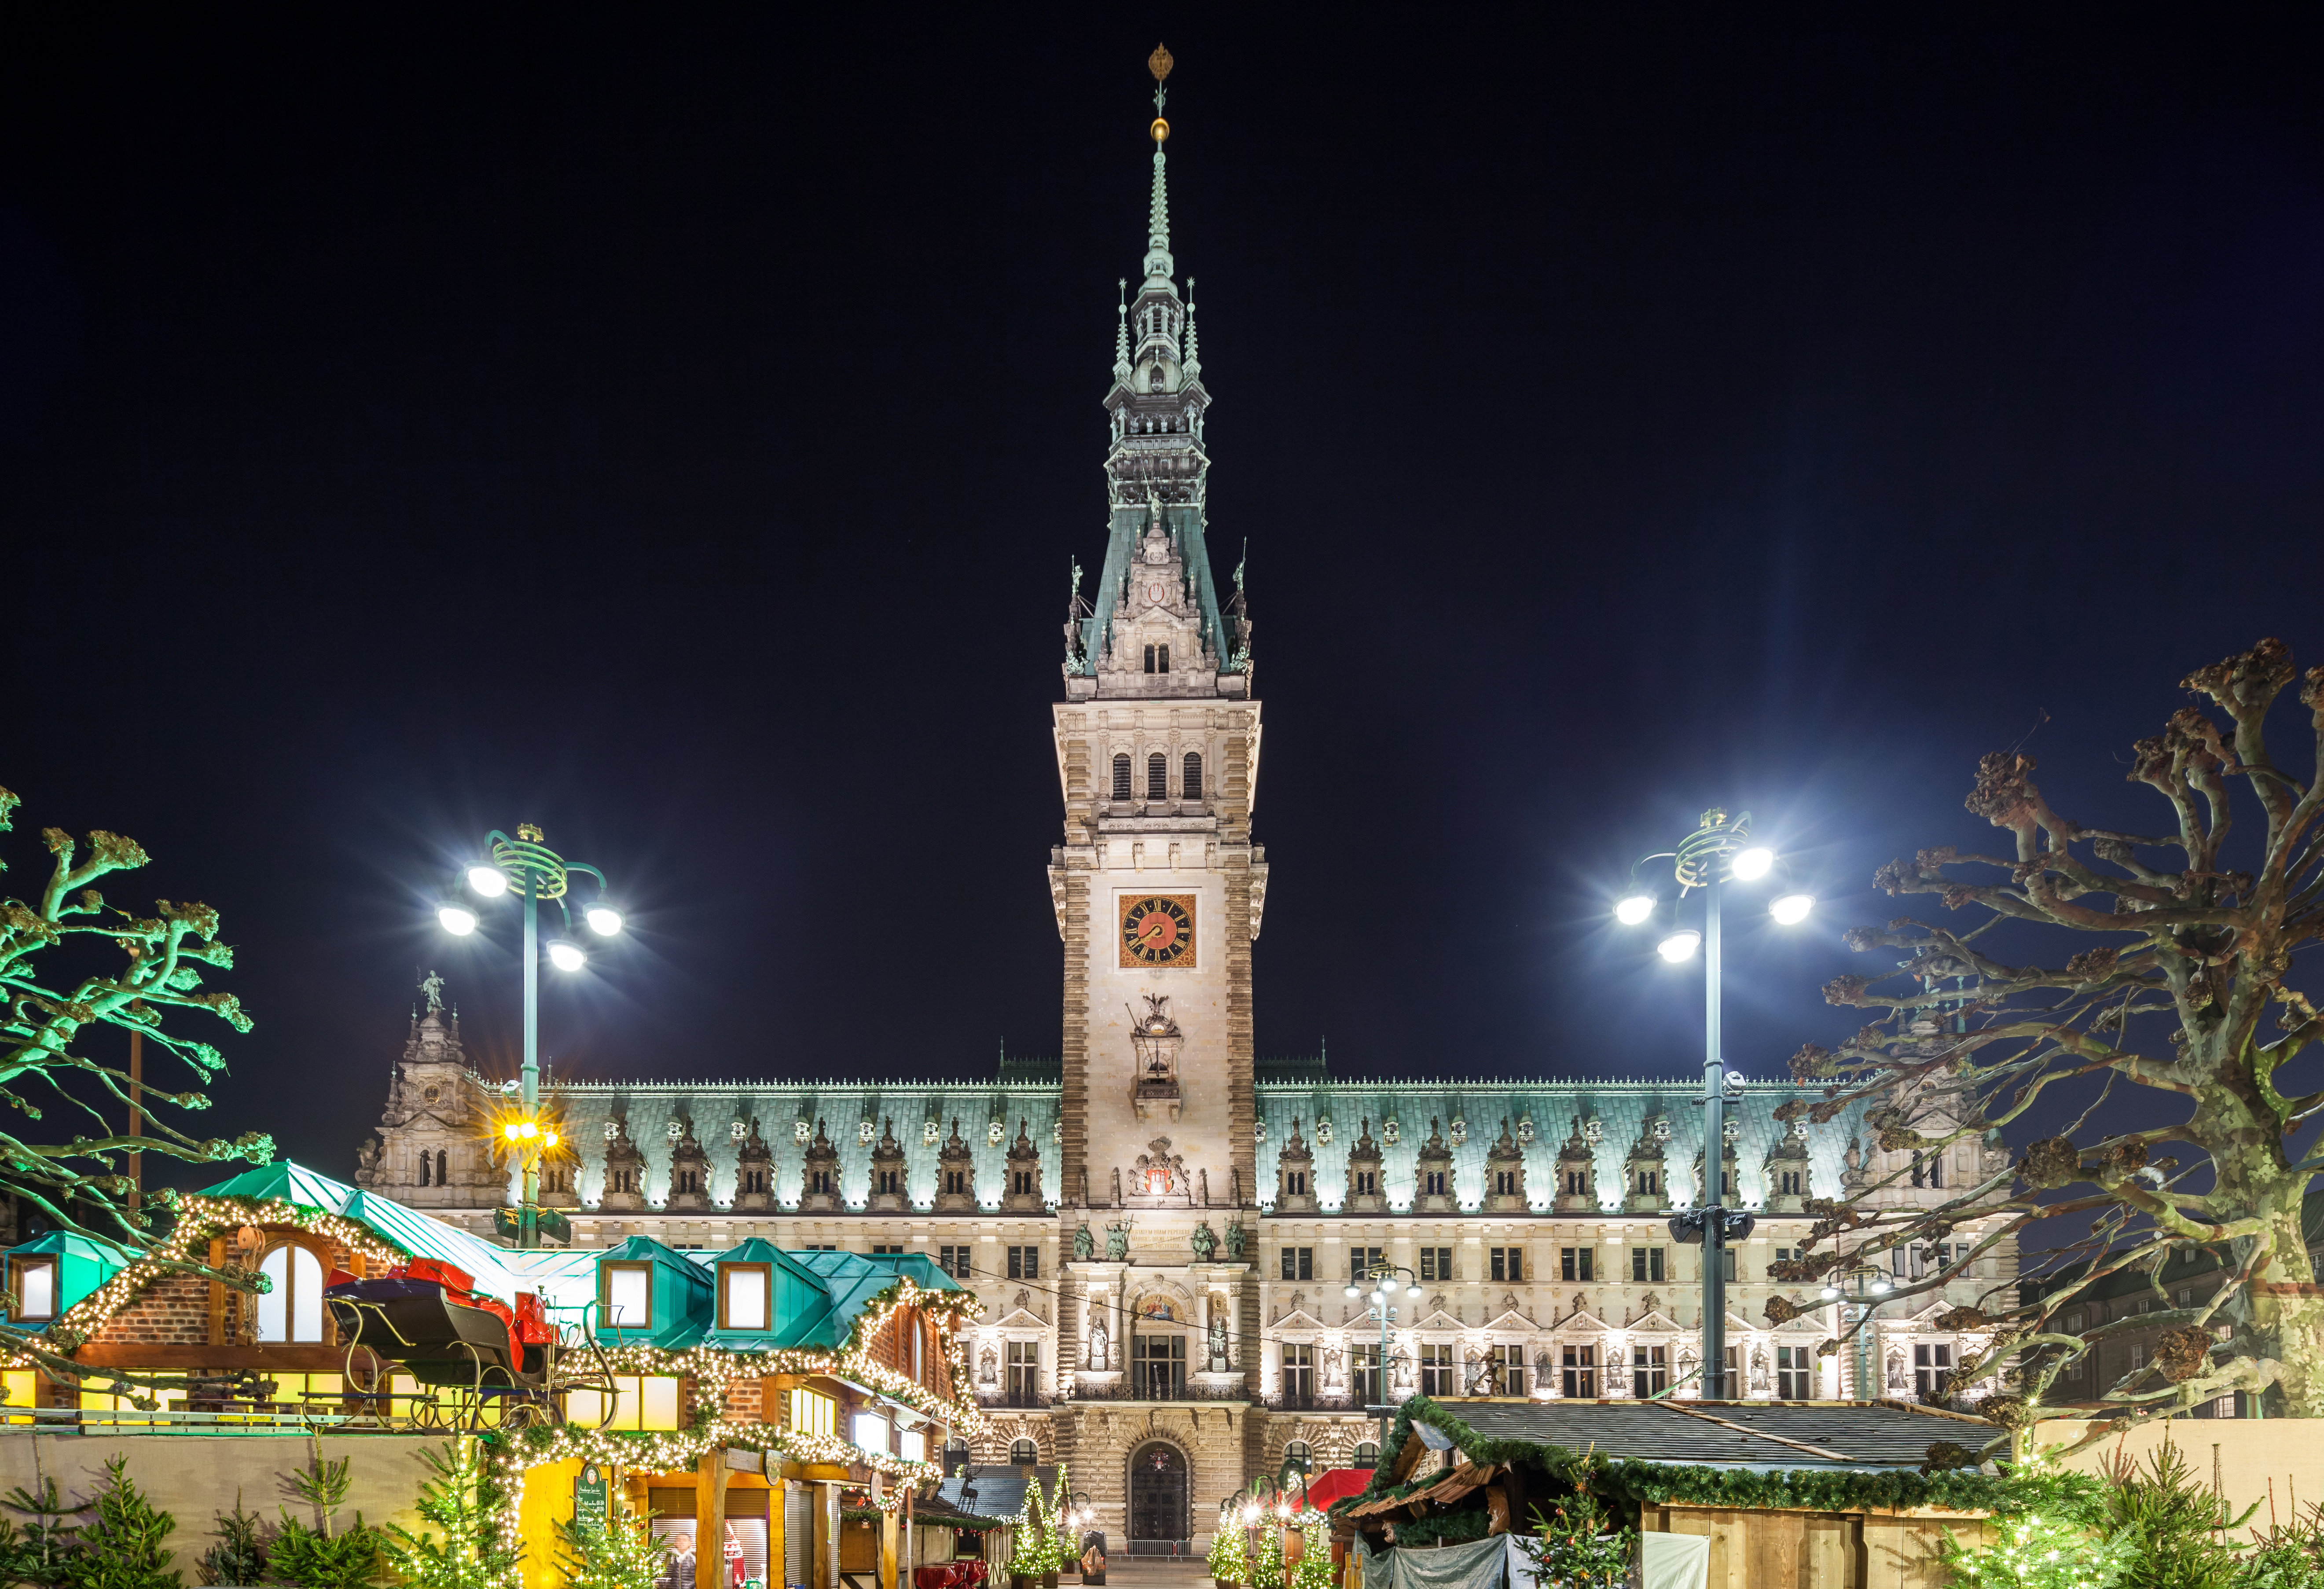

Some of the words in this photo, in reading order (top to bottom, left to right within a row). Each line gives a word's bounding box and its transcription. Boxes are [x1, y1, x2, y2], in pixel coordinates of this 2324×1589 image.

[1140, 903, 1149, 915] XI
[1153, 900, 1162, 911] XII
[1129, 914, 1141, 923] X
[1174, 914, 1186, 922] II
[1128, 937, 1139, 950] III
[1154, 950, 1161, 961] VI
[1167, 947, 1175, 958] V
